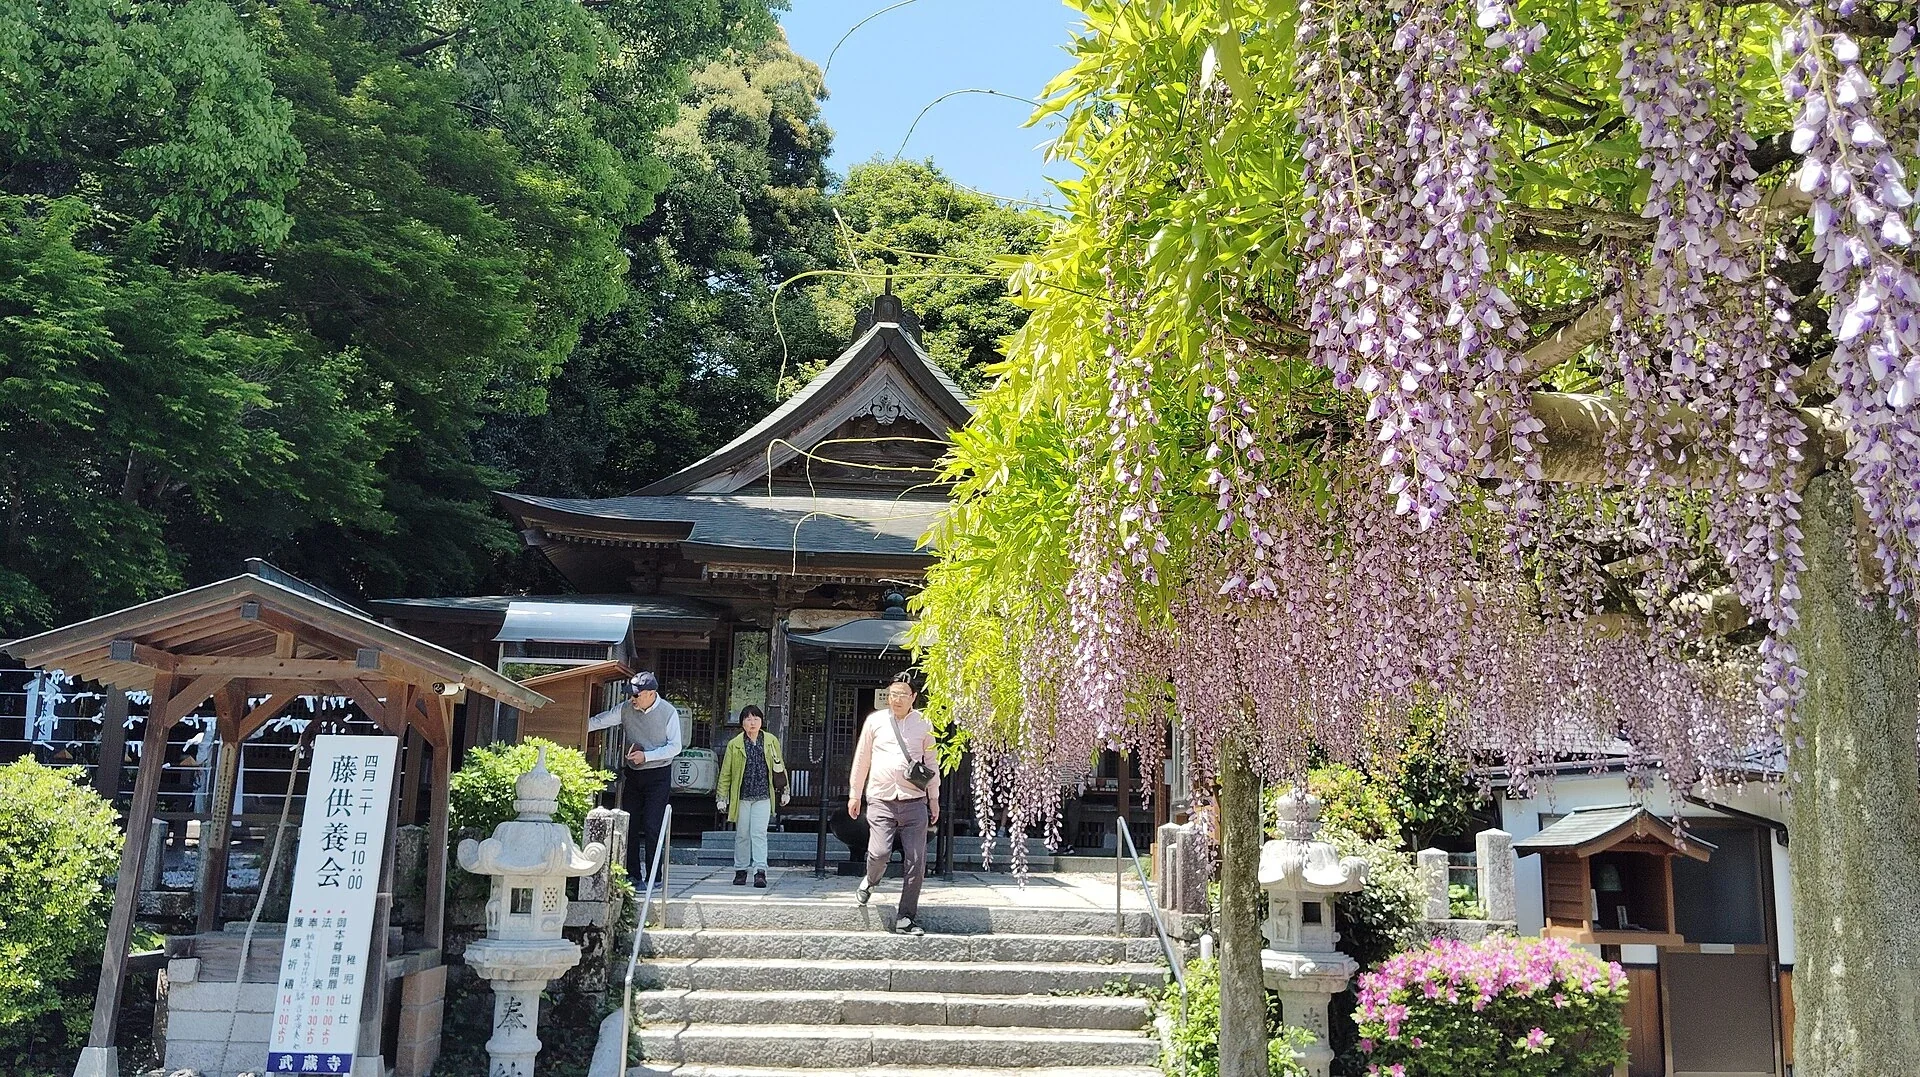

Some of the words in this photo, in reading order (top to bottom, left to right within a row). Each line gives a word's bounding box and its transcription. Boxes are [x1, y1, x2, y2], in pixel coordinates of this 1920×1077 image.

[315, 754, 359, 889] 藤供養会
[278, 1054, 342, 1072] 武蔵寺
